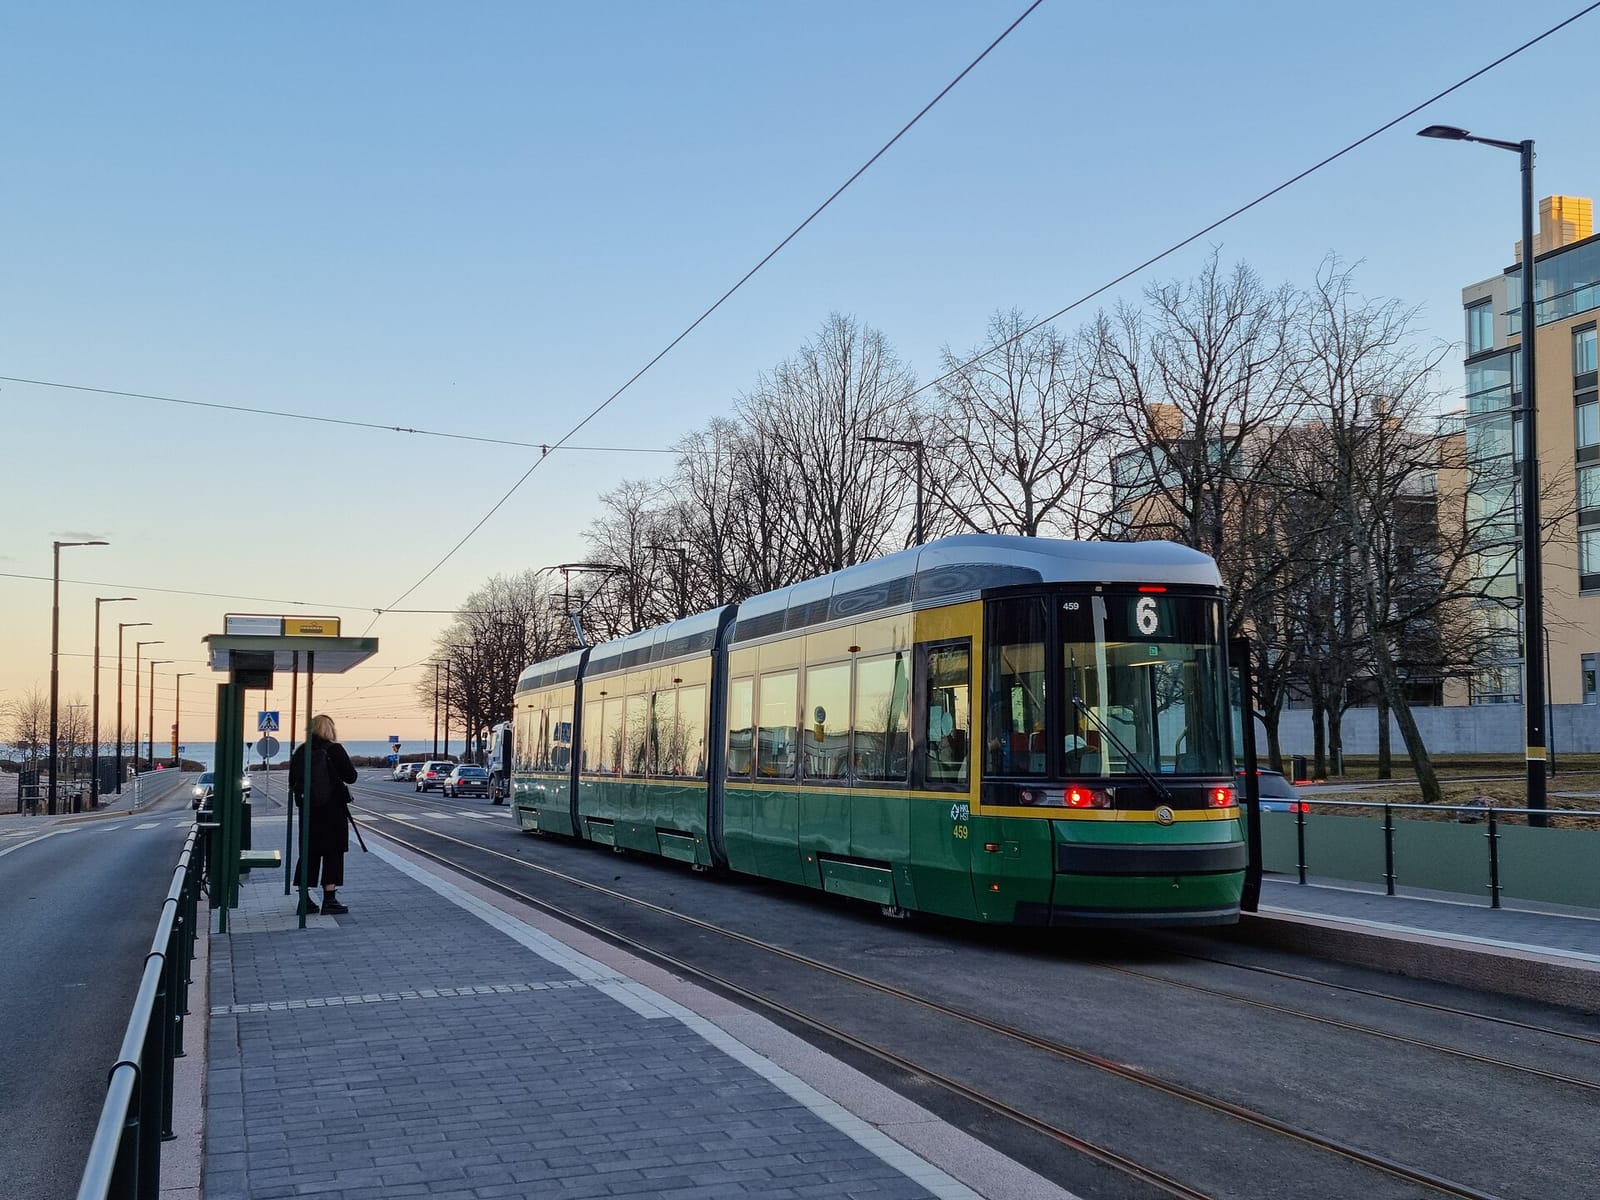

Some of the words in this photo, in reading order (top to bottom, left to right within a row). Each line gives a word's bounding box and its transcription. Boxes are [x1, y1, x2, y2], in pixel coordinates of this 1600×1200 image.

[1062, 602, 1080, 610] 459
[1136, 597, 1158, 635] 6
[953, 825, 968, 839] 459
